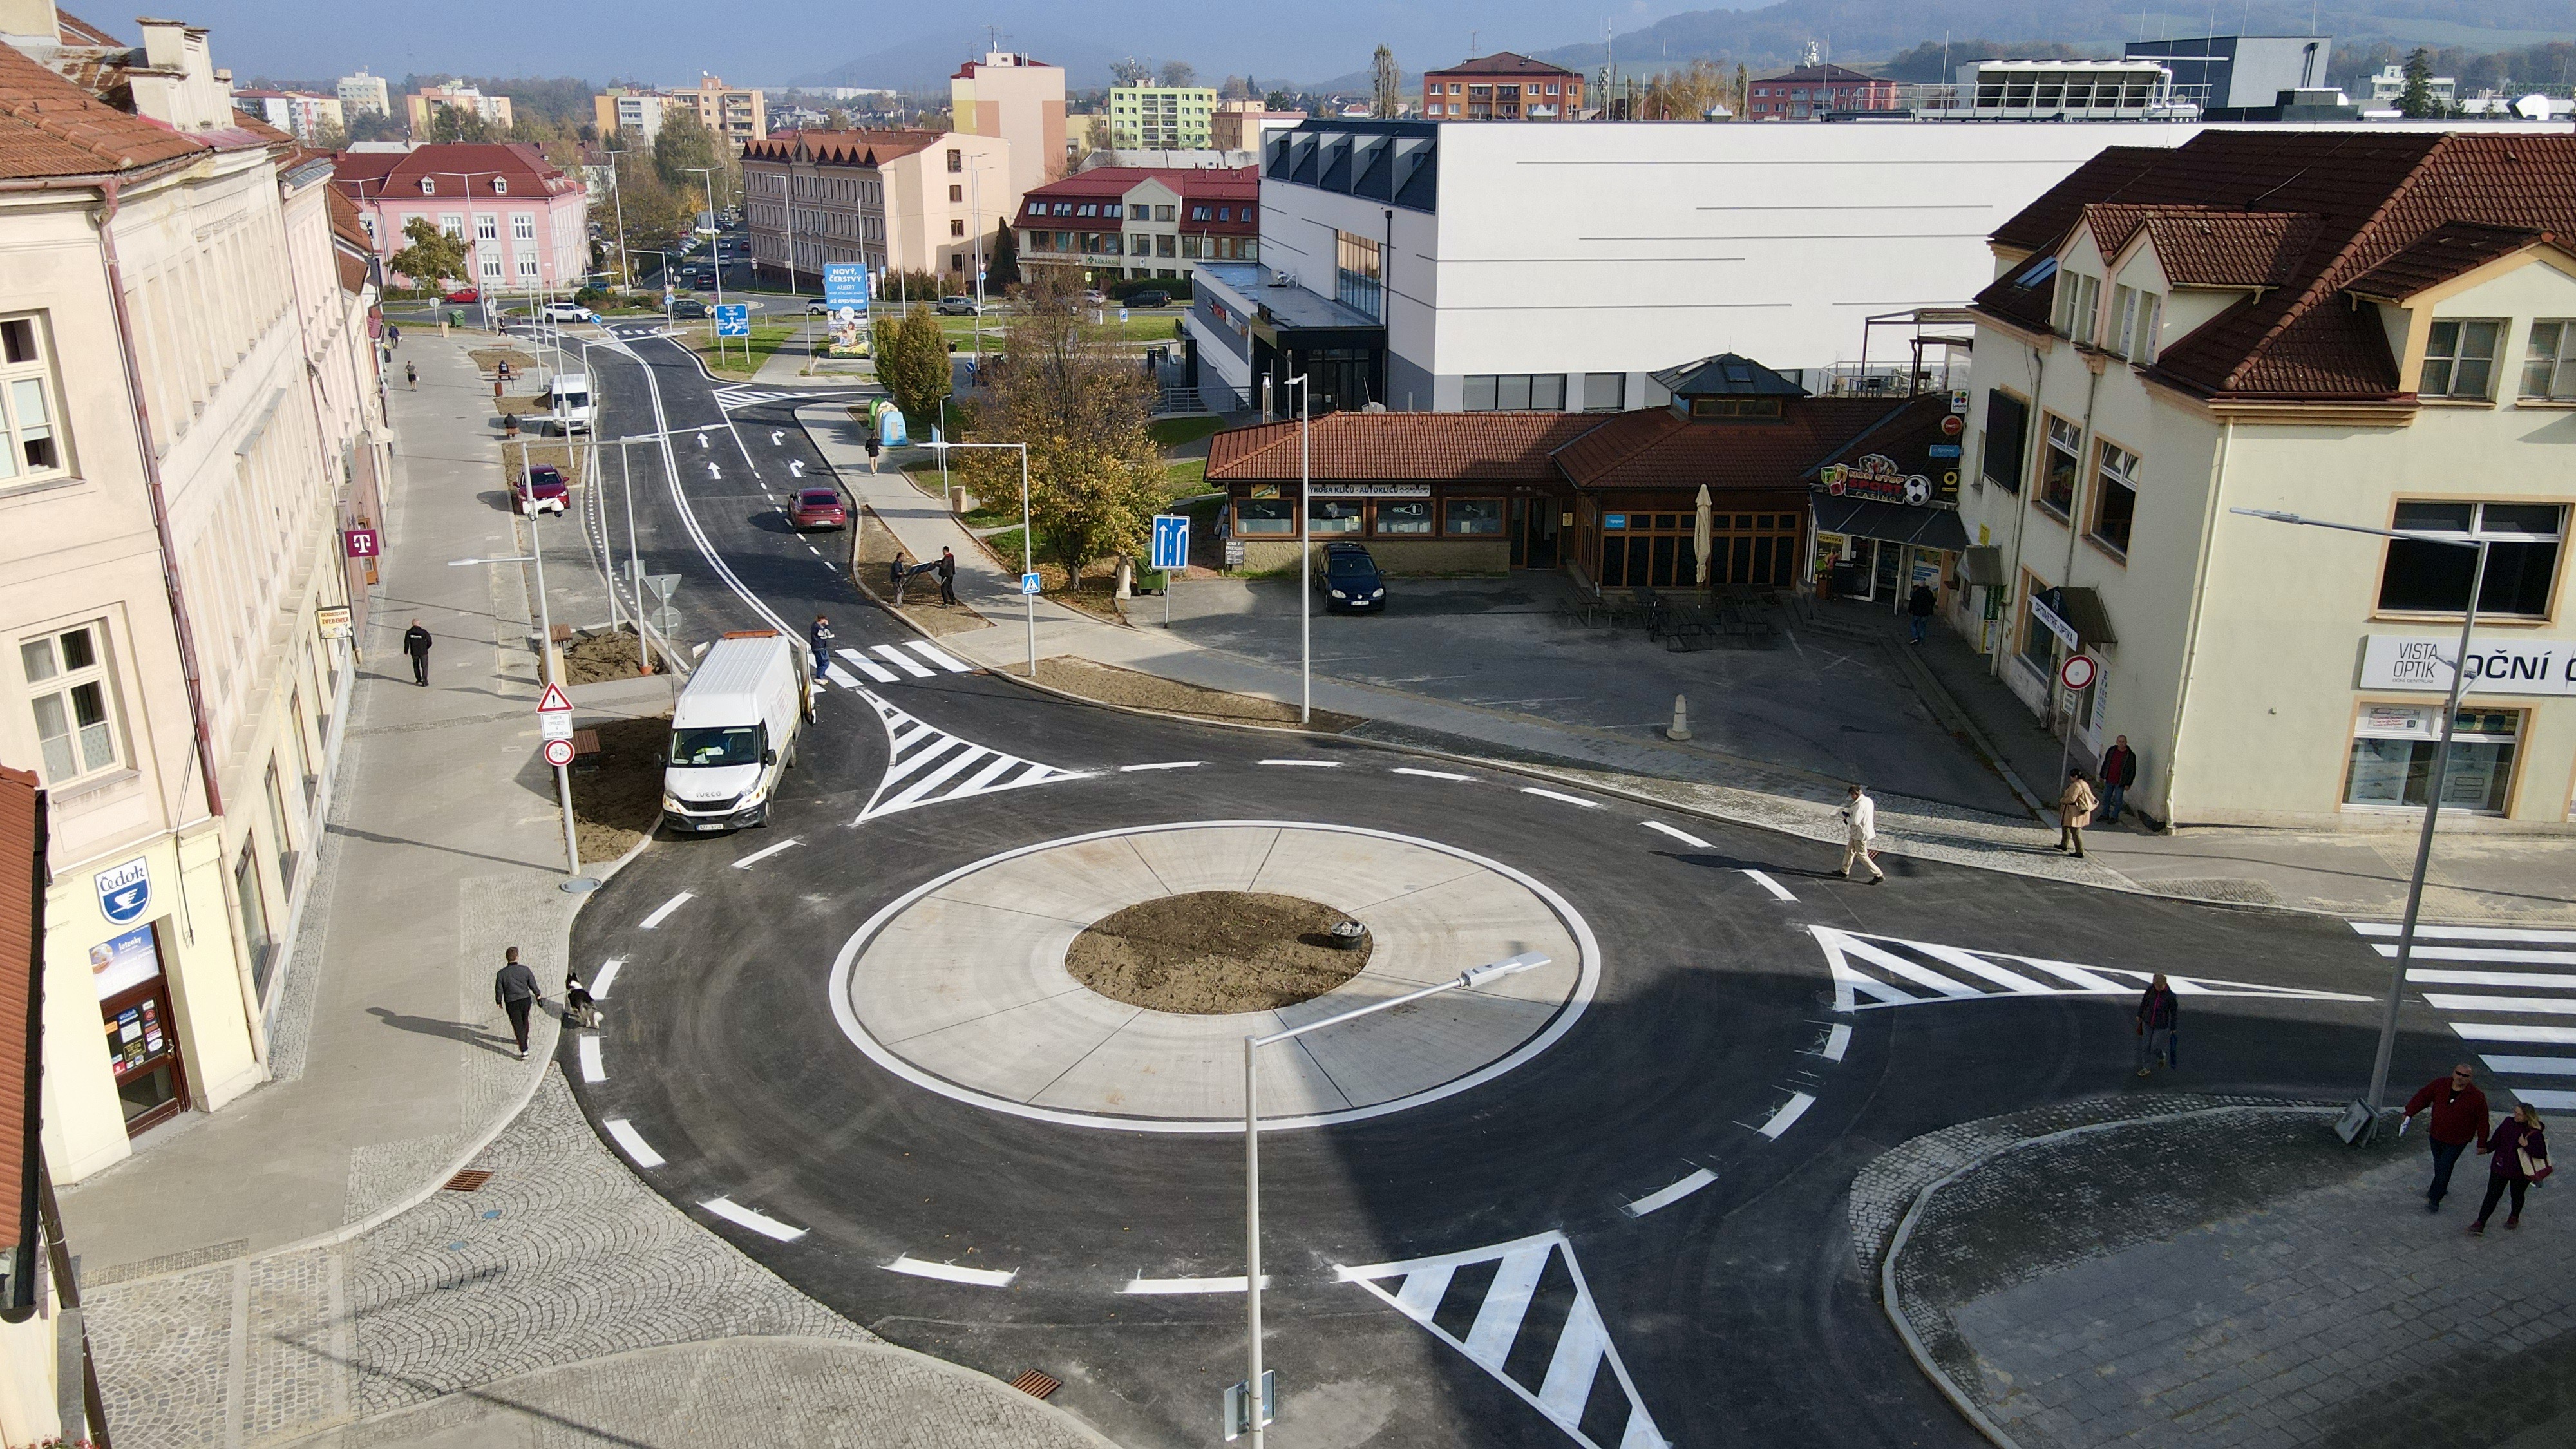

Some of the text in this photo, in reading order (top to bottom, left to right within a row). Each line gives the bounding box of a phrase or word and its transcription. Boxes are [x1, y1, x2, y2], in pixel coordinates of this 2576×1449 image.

[833, 267, 857, 276] NOVÝ,
[1849, 470, 1904, 484] NON STOP
[1849, 478, 1903, 493] SPORT
[1855, 491, 1897, 502] CASINO
[354, 534, 371, 553] T
[2399, 643, 2438, 661] VISTA
[2393, 660, 2436, 678] OPTIK
[100, 866, 145, 892] Čedok
[118, 936, 142, 951] letenky
